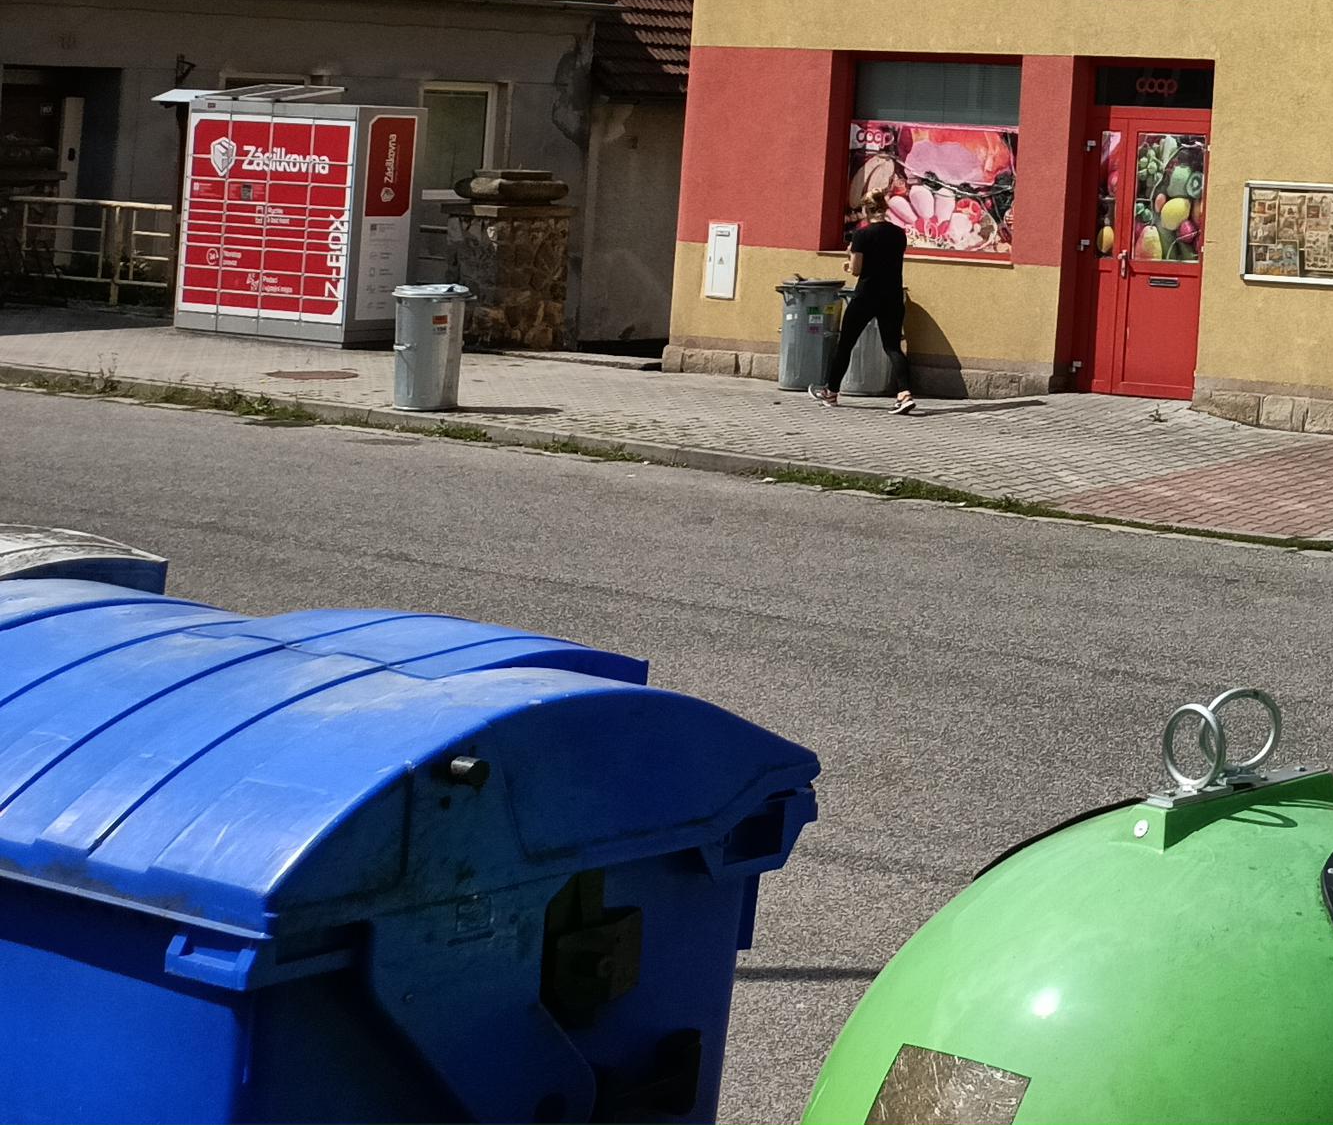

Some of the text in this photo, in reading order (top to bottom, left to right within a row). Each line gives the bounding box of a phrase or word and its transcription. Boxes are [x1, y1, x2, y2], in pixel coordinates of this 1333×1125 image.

[1136, 78, 1178, 97] coop
[856, 128, 895, 149] coop
[242, 144, 330, 175] Zásilkovna
[324, 213, 346, 300] Z-BOX
